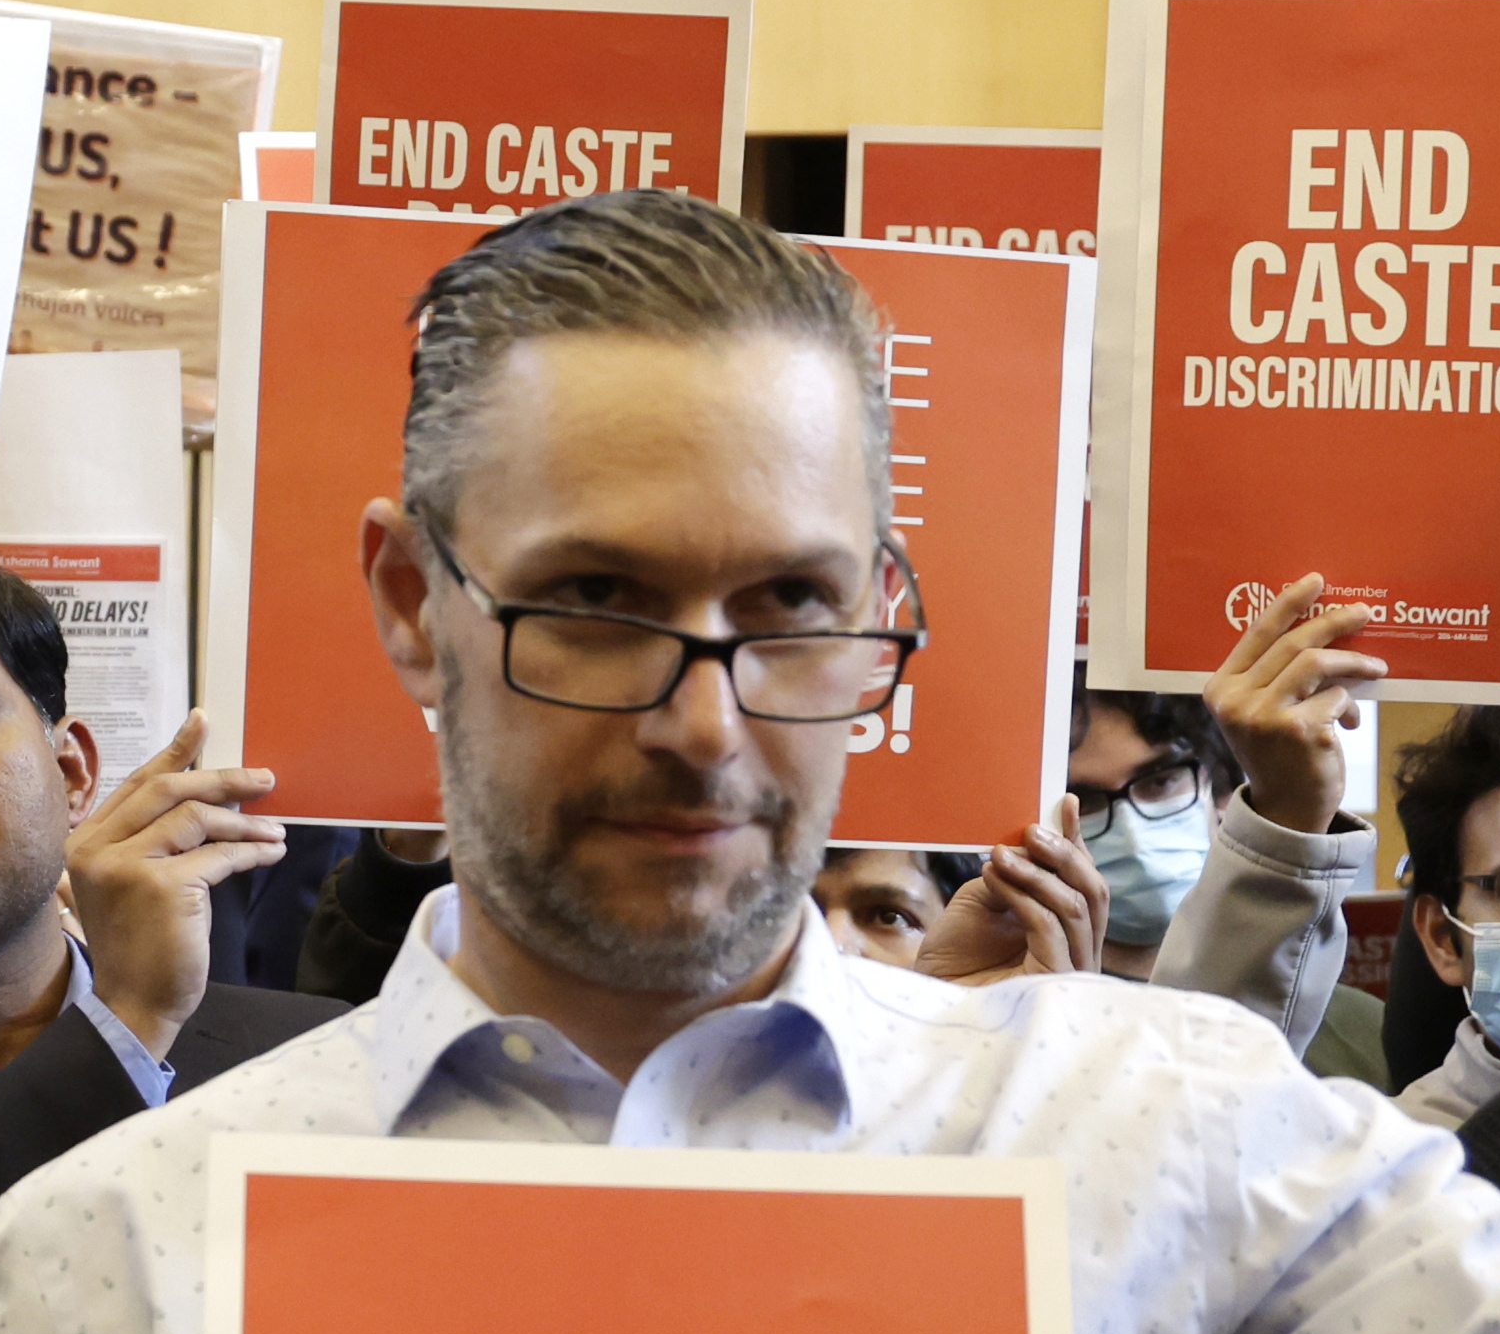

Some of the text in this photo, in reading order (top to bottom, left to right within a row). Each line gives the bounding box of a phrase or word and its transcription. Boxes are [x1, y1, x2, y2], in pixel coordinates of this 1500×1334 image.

[358, 116, 469, 190] END
[1287, 128, 1470, 231] END
[52, 555, 101, 568] Sawant
[70, 600, 149, 623] DELAYS!
[1392, 600, 1490, 626] Sawant
